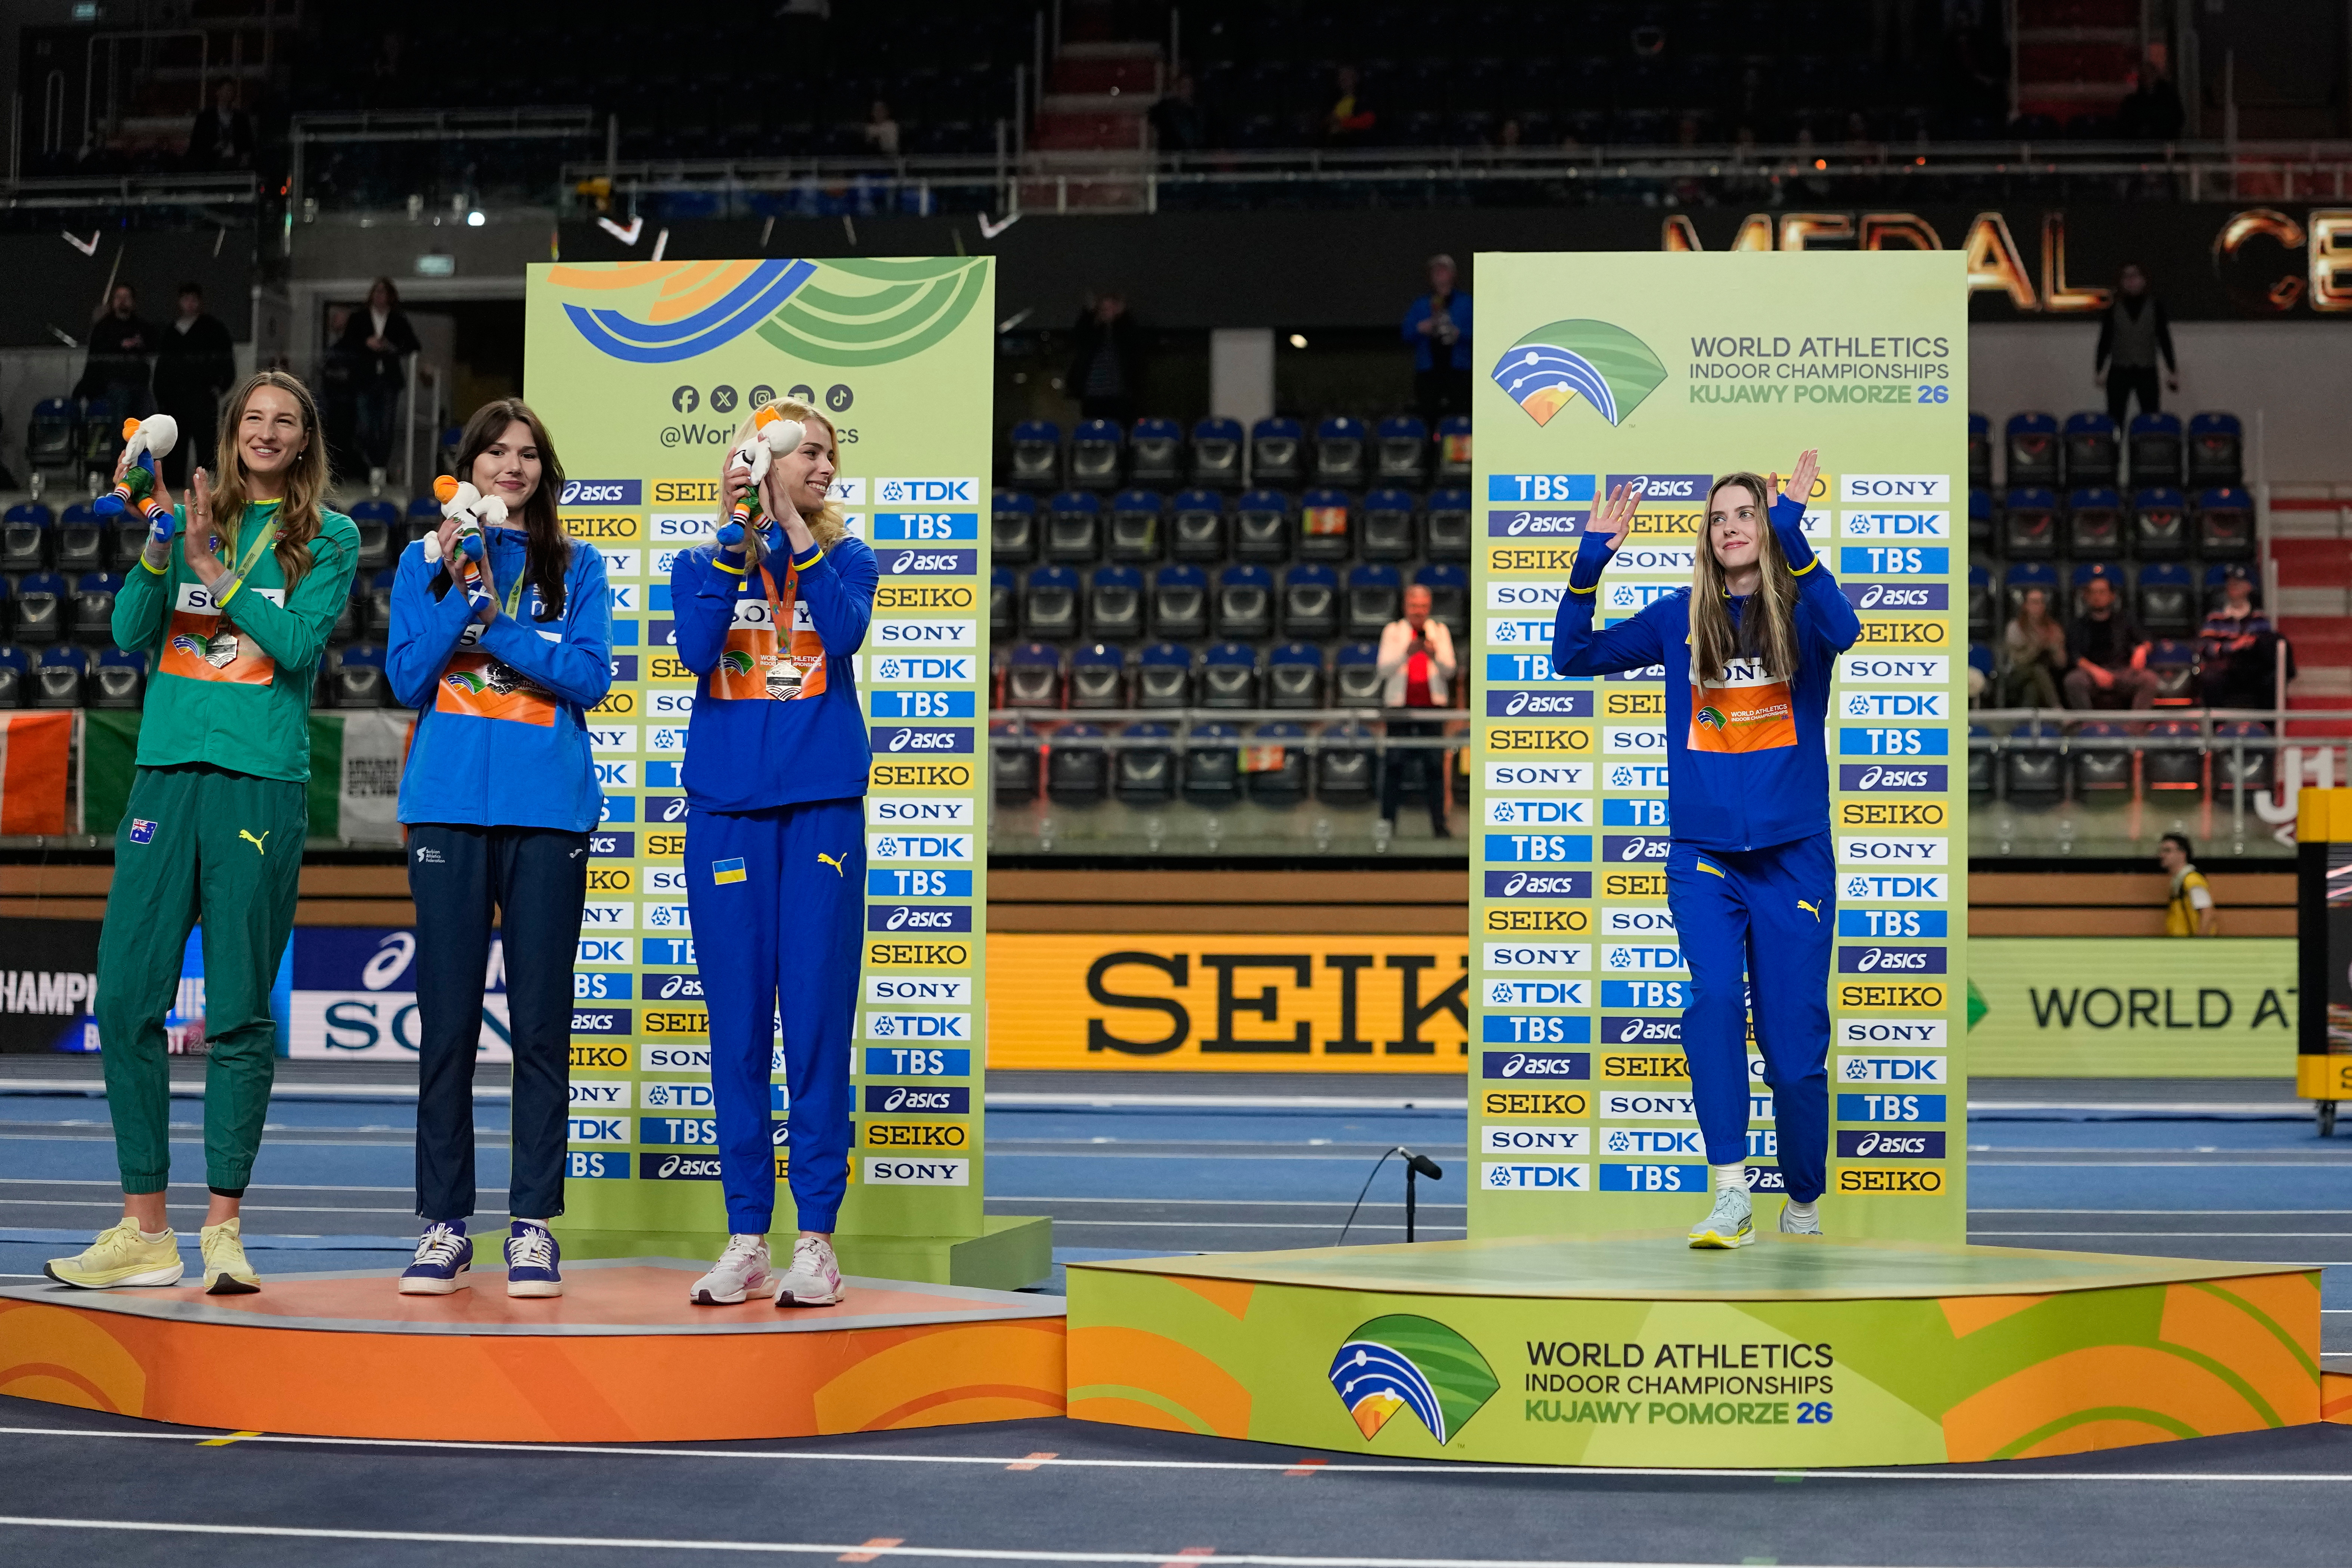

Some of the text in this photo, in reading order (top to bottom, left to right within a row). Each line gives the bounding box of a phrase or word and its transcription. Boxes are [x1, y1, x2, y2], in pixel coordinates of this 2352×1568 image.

[1691, 337, 1949, 357] WORLD ATHLETICS
[1691, 363, 1949, 379] INDOOR CHAMPIONSHIPS
[1690, 385, 1949, 404] KUJAWY POMORZE 26
[579, 486, 623, 500] asics
[904, 482, 968, 500] TDK
[1515, 477, 1569, 500] TBS
[1648, 481, 1693, 499] asics
[1852, 481, 1938, 495] SONY
[563, 517, 636, 538] EIKO
[661, 520, 718, 534] SON
[900, 515, 951, 538] TBS
[1529, 517, 1575, 532] asics
[1871, 515, 1939, 534] TDK
[913, 555, 958, 570] asics
[1868, 548, 1922, 571] TBS
[876, 588, 972, 607] SEIKO
[1499, 589, 1566, 603] SON
[1882, 587, 1928, 605] asics
[883, 626, 964, 640] SONY
[1517, 623, 1554, 642] TD
[901, 660, 966, 678] TDK
[1851, 662, 1935, 676] SONY
[657, 696, 692, 710] SO
[897, 692, 948, 716] TBS
[1528, 696, 1574, 712] asics
[1609, 693, 1665, 715] SEI
[1756, 704, 1787, 715] ATHLETICS
[1870, 696, 1938, 715] TDK
[1751, 710, 1788, 721] CHAMPIONSHIPS
[590, 731, 624, 746] NY
[911, 734, 955, 748] asics
[1491, 731, 1588, 749] SEIKO
[1867, 729, 1921, 752] TBS
[874, 766, 969, 785] SEIKO
[1497, 769, 1580, 783] SONY
[1881, 768, 1928, 786] asics
[880, 804, 962, 818] SONY
[1515, 803, 1583, 821] TDK
[1630, 801, 1668, 824] TB
[1844, 805, 1942, 824] SEIKO
[589, 838, 616, 853] sics
[898, 838, 963, 856] TDK
[1512, 836, 1565, 859] TBS
[1644, 843, 1670, 858] asi
[1850, 843, 1936, 858] SONY
[894, 871, 946, 894] TBS
[1525, 875, 1572, 892] asics
[1607, 876, 1668, 896] SEI
[1869, 878, 1937, 897] TDK
[583, 908, 622, 923] NY
[908, 912, 952, 927] asics
[1489, 911, 1587, 930] SEIKO
[1613, 915, 1674, 929] SON
[1866, 911, 1920, 935] TBS
[579, 941, 623, 960] DK
[872, 945, 966, 964] SEIKO
[1495, 949, 1580, 964] SONY
[1631, 949, 1684, 969] TD
[1880, 953, 1927, 968] asics
[574, 975, 607, 998] BS
[877, 983, 960, 997] SONY
[1512, 983, 1581, 1003] TDK
[1628, 983, 1682, 1006] TBS
[1087, 951, 1468, 1056] SEIK
[1843, 987, 1942, 1006] SEIKO
[2029, 987, 2233, 1029] WORLD
[571, 1015, 613, 1029] asics
[895, 1016, 961, 1036] TDK
[1510, 1018, 1564, 1041] TBS
[1642, 1022, 1680, 1039] asic
[1849, 1025, 1935, 1040] SONY
[570, 1049, 627, 1069] IKO
[652, 1052, 711, 1066] SON
[892, 1051, 943, 1075] TBS
[1524, 1057, 1570, 1074] asics
[1866, 1060, 1936, 1079] TDK
[569, 1087, 620, 1101] NY
[669, 1084, 712, 1106] TD
[906, 1094, 950, 1107] asics
[1487, 1094, 1585, 1114] SEIKO
[1611, 1097, 1694, 1112] SONY
[1865, 1095, 1918, 1119] TBS
[666, 1119, 716, 1143] TBS
[870, 1125, 964, 1146] SEIKO
[1493, 1132, 1578, 1147] SONY
[1630, 1132, 1698, 1152] TDK
[1747, 1131, 1776, 1154] TB
[1879, 1138, 1925, 1152] asics
[566, 1154, 604, 1177] BS
[680, 1161, 721, 1175] asics
[875, 1163, 958, 1178] SONY
[1512, 1167, 1580, 1187] TDK
[1627, 1166, 1680, 1189] TBS
[1841, 1171, 1940, 1191] SEIKO
[1527, 1341, 1833, 1369] WORLD ATHLETICS
[1526, 1374, 1833, 1394] INDOOR CHAMPIONSHIPS
[1526, 1400, 1833, 1424] KUJAWY POMORZE 26
